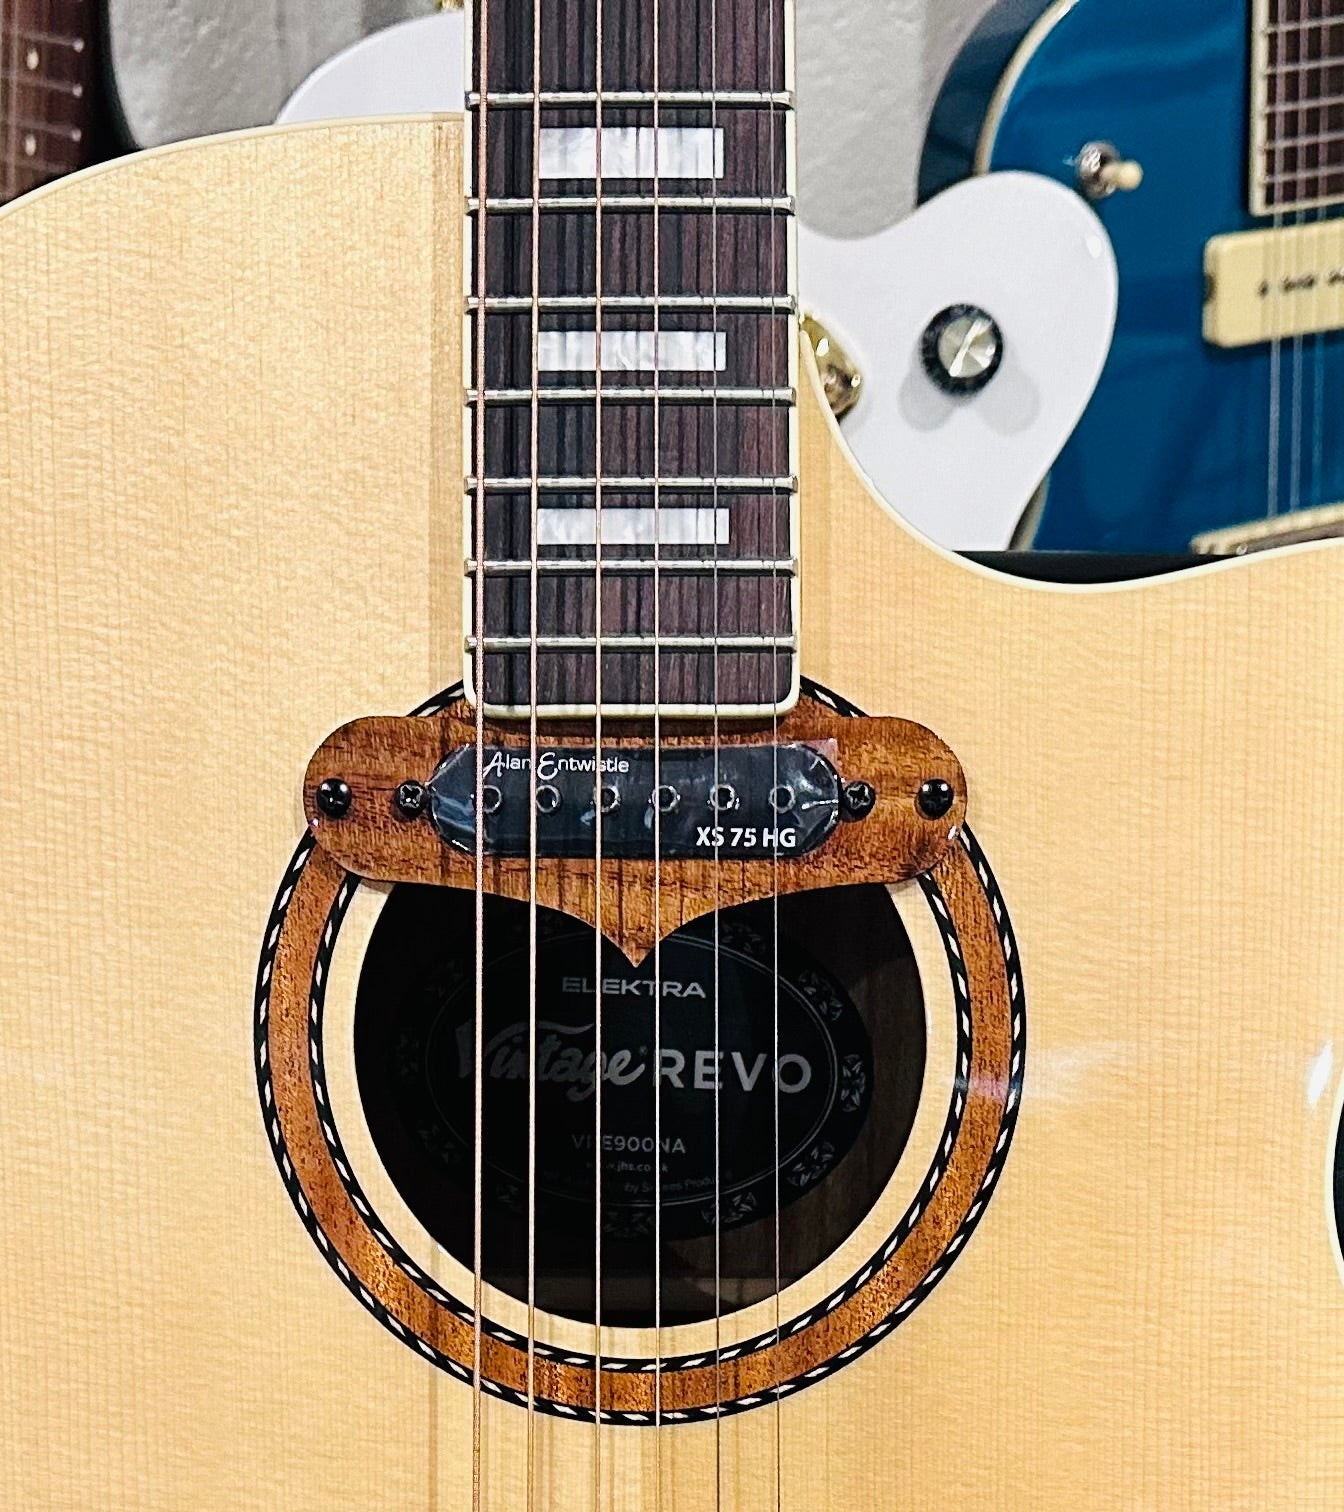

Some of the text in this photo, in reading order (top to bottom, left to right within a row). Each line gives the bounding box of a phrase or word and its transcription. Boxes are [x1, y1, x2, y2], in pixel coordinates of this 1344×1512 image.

[482, 751, 630, 780] Alan Entwistle
[696, 826, 796, 849] XS 75 HG
[562, 976, 706, 999] ELEKTRA
[653, 1048, 812, 1096] REVO
